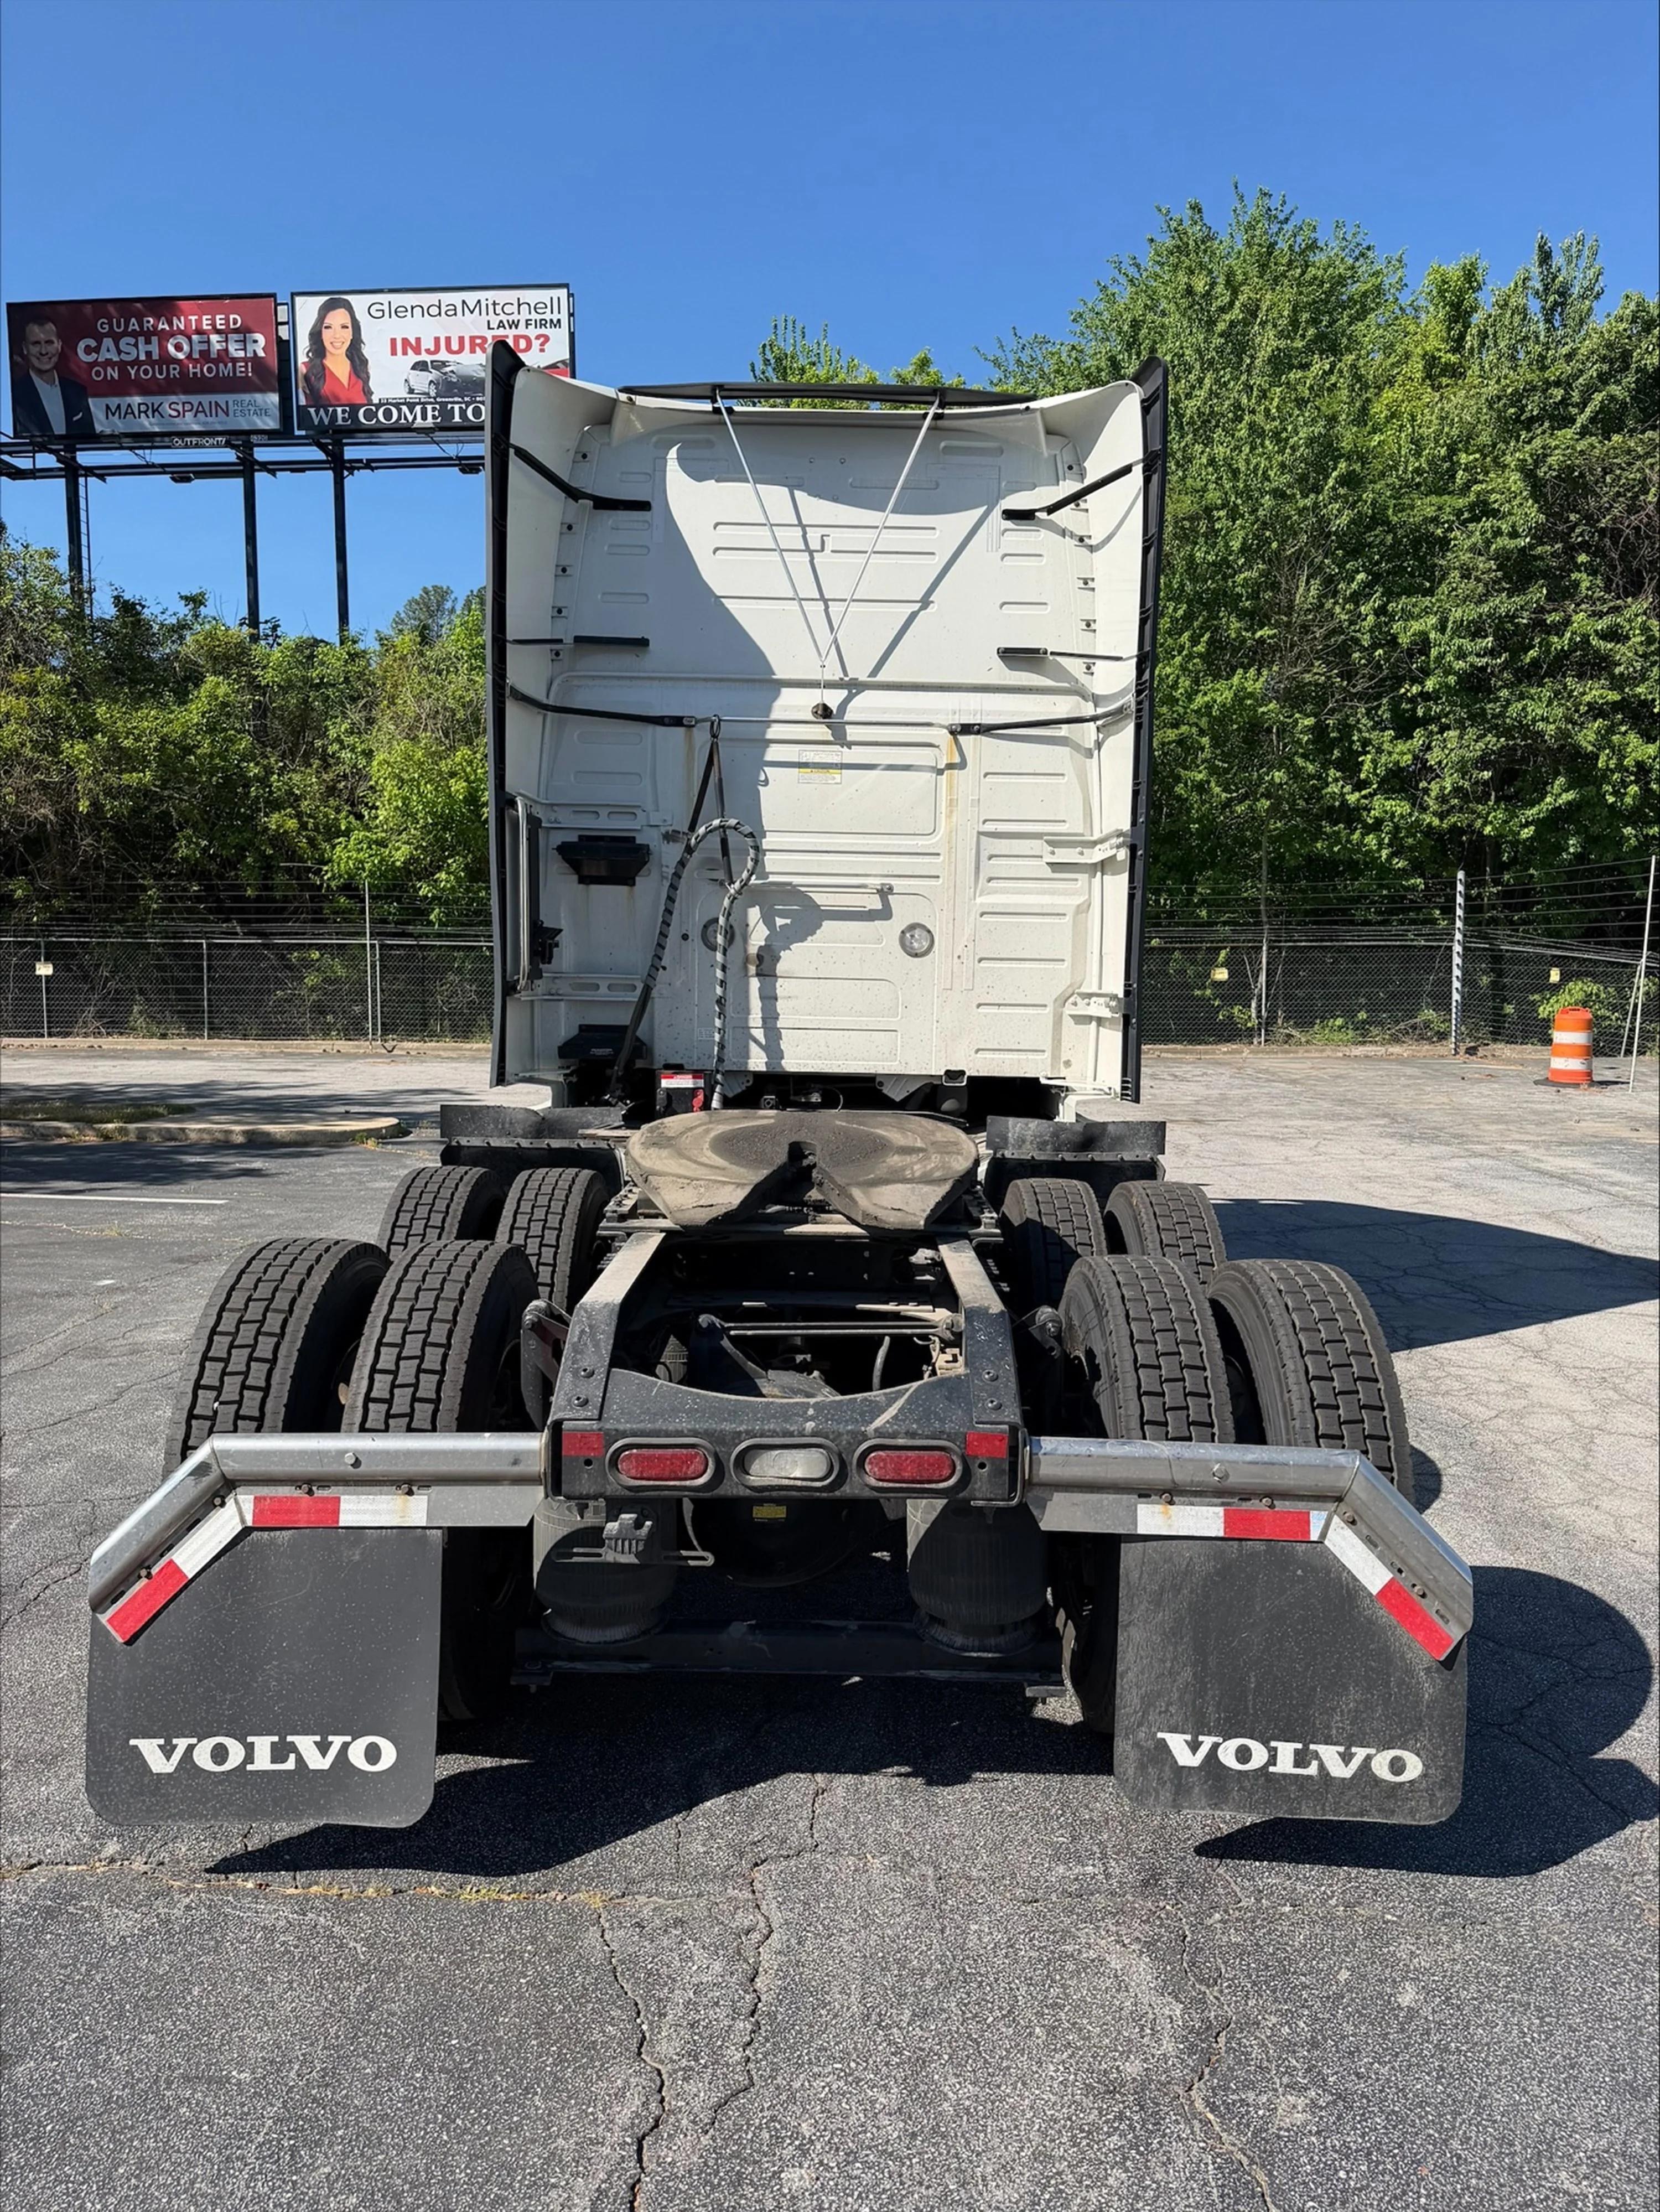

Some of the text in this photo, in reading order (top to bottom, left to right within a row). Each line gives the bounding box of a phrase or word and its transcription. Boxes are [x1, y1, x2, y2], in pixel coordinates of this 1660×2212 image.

[367, 296, 561, 319] GlendaMitchell
[97, 314, 242, 333] GUARANTEED
[487, 318, 562, 330] LAW FIRM
[76, 333, 266, 362] CASH OFFER
[390, 333, 551, 356] INJURD?
[91, 362, 252, 381] ON YOUR HOME!
[105, 400, 230, 421] MARK SPAIN
[232, 399, 260, 409] REAL
[233, 408, 271, 418] ESTATE
[308, 403, 485, 426] WE COME TO
[129, 1736, 397, 1774] VOLVO
[1156, 1732, 1424, 1783] VOLVO
